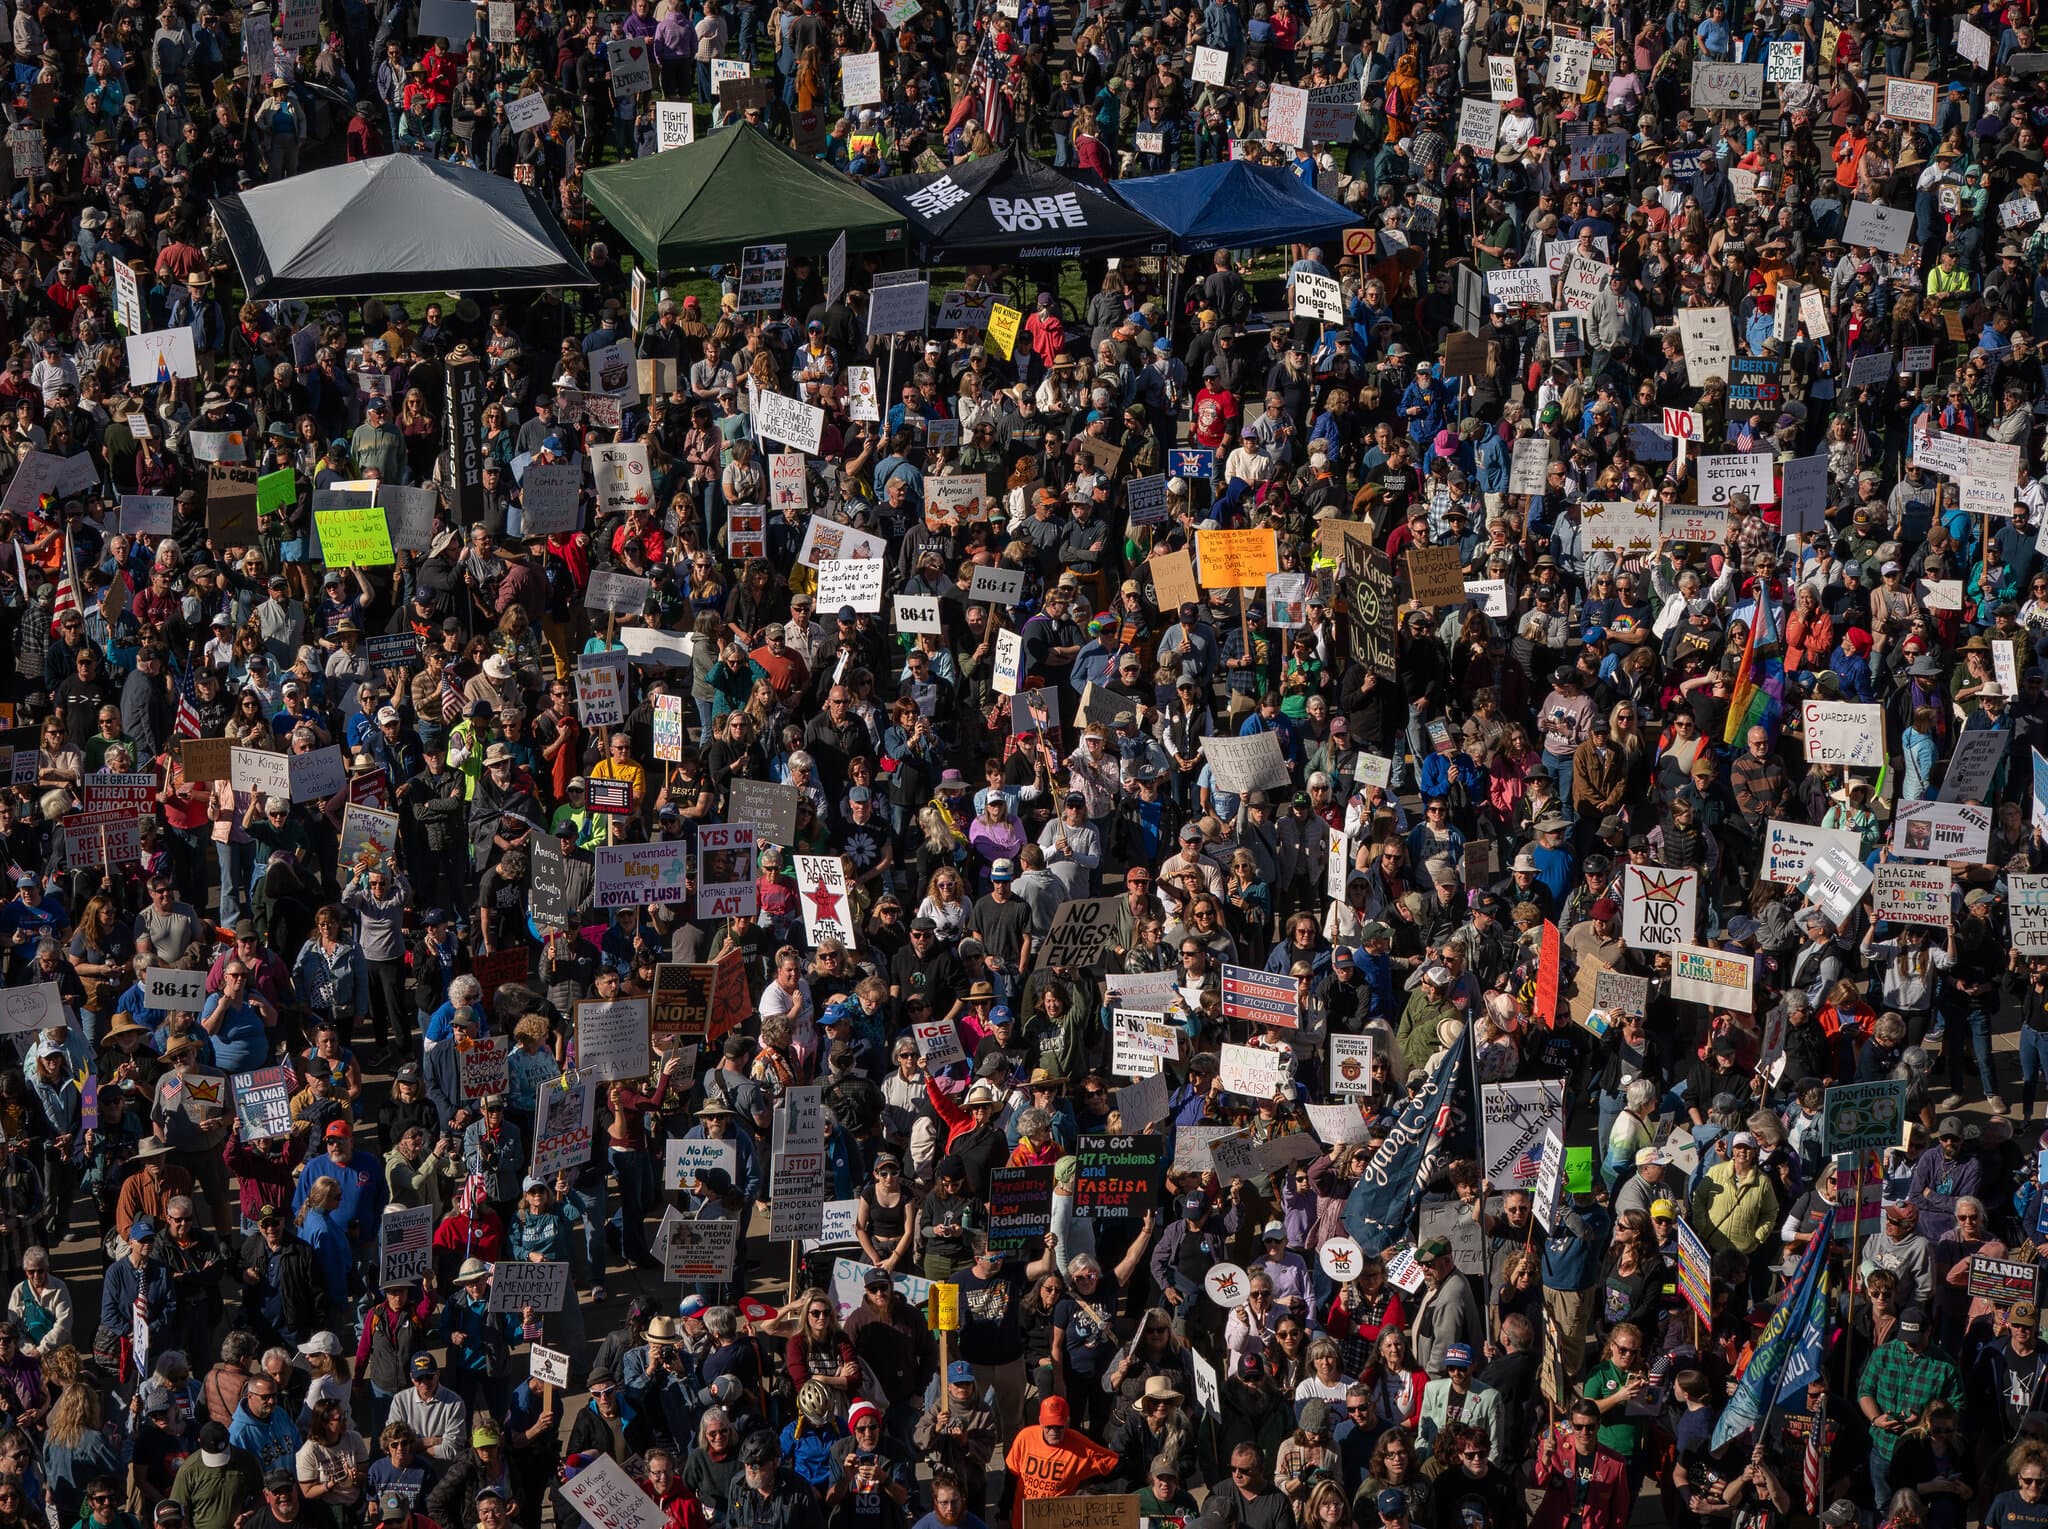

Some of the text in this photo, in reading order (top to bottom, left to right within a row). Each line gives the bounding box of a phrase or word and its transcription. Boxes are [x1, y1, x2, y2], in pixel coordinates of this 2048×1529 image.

[1770, 43, 1792, 55] POWER
[1566, 58, 1577, 66] IS
[1775, 56, 1784, 66] TO
[1491, 62, 1503, 76] NO
[1770, 66, 1802, 80] PEOPLE!
[1492, 78, 1513, 92] KING
[1555, 73, 1578, 85] SIN
[662, 111, 687, 122] FIGHT
[1466, 104, 1493, 116] IMAGINE
[1468, 113, 1490, 123] BEING
[663, 121, 688, 134] TRUTH
[1461, 128, 1493, 139] DIVERSITY
[663, 133, 687, 145] DECAY
[927, 174, 971, 208] BABE
[903, 187, 950, 220] VOTE
[986, 191, 1078, 218] BABE
[994, 212, 1088, 233] VOTE
[1019, 246, 1081, 258] babevote.org
[1573, 258, 1601, 272] ONLY
[1489, 269, 1529, 280] PROTECT
[1296, 273, 1338, 292] NO Kings
[1312, 289, 1326, 299] NO
[1494, 285, 1540, 296] GRANDKIDS
[1297, 295, 1342, 314] Oligarchs
[944, 310, 962, 320] NO
[1731, 359, 1778, 374] LIBERTY
[1741, 374, 1765, 384] AND
[1729, 398, 1776, 411] FOR ALL
[460, 370, 478, 487] IMPEACH
[1710, 457, 1747, 466] ARTICLE
[1920, 455, 1956, 471] MEDICAID
[774, 468, 801, 478] KINGS
[1707, 469, 1747, 478] SECTION
[1966, 489, 2005, 502] AMERICA
[317, 512, 365, 524] VAGINAS
[1671, 528, 1716, 540] CRUELTY
[1415, 548, 1453, 562] FIGHT
[821, 561, 840, 572] 250
[1345, 540, 1393, 589] No Kings
[1410, 562, 1461, 576] IGNORANCE
[976, 578, 1016, 593] 8647
[1429, 575, 1447, 585] NOT
[1415, 584, 1461, 596] IMMIGRANTS
[900, 608, 935, 621] 8647
[1350, 623, 1397, 671] No Nazis
[585, 710, 618, 724] ABIDE
[1805, 704, 1867, 725] GUARDIANS
[654, 744, 682, 761] GREAT
[238, 753, 284, 772] No Kings
[91, 775, 151, 785] THE GREATEST
[240, 771, 289, 788] Since 1776
[91, 788, 147, 799] THREAT TO
[672, 787, 696, 796] RESIST
[1895, 802, 1936, 821] CORRUPTION
[1958, 808, 1989, 830] HATE
[1935, 823, 1966, 832] DEPORT
[700, 831, 753, 847] YES ON
[1935, 831, 1964, 843] HIM
[70, 852, 95, 865] THE
[600, 848, 678, 865] This wannabe
[624, 862, 659, 880] King
[801, 858, 836, 875] RAGE
[806, 873, 842, 886] AGAINST
[1878, 870, 1926, 879] IMAGINE
[600, 880, 645, 889] Deserves
[1878, 880, 1944, 889] BEING AFRAID
[2013, 877, 2039, 890] The
[601, 887, 681, 906] ROYAL FLUSH
[712, 896, 742, 915] ACT
[1881, 902, 1922, 910] BUT NOT
[1065, 902, 1100, 924] NO
[1644, 902, 1678, 925] NO
[1876, 910, 1950, 925] DICTATORSHIP
[820, 921, 836, 930] THE
[1045, 925, 1110, 946] KINGS
[1640, 926, 1681, 944] KINGS
[1046, 945, 1096, 966] EVER
[1247, 972, 1280, 984] MAKE
[152, 982, 200, 998] 8647
[1242, 984, 1286, 999] ORWELL
[1243, 997, 1286, 1011] FICTION
[656, 1006, 704, 1021] NOPE
[1248, 1010, 1280, 1023] AGAIN
[917, 1024, 952, 1038] ICE
[474, 1039, 494, 1050] NO
[927, 1036, 947, 1047] OUT
[1336, 1048, 1368, 1056] PREVENT
[236, 1070, 281, 1087] NO KING
[464, 1079, 507, 1096] WAR!
[1335, 1082, 1367, 1090] FASCISM
[246, 1087, 285, 1103] NO WAR
[803, 1096, 816, 1105] WE
[1832, 1090, 1887, 1101] abortion
[266, 1102, 286, 1117] NO
[802, 1109, 817, 1118] ARE
[269, 1117, 290, 1132] ICE
[536, 1125, 592, 1153] SCHOOL
[1080, 1136, 1134, 1149] I've Got
[1832, 1135, 1897, 1150] healthcare
[686, 1145, 723, 1159] No Kings
[678, 1156, 690, 1166] No
[789, 1158, 816, 1169] STOP
[1079, 1153, 1156, 1165] 47 Problems
[1080, 1165, 1106, 1178] and
[774, 1200, 822, 1210] DEMOCRACY
[1094, 1205, 1129, 1217] Them
[386, 1215, 431, 1230] CONSTITUTION
[788, 1213, 806, 1221] NOT
[990, 1213, 1050, 1227] Rebellion
[774, 1222, 819, 1233] OLIGARCHY
[389, 1251, 417, 1265] NOT
[506, 1263, 557, 1281] FIRST
[1973, 1260, 2034, 1279] HANDS
[497, 1281, 560, 1293] AMENDMENT
[1223, 1286, 1238, 1295] NO
[1027, 1456, 1067, 1480] DUE
[856, 1495, 880, 1507] NO
[1032, 1502, 1125, 1518] NORMAL PEOPLE
[1093, 1516, 1119, 1527] VOTE
